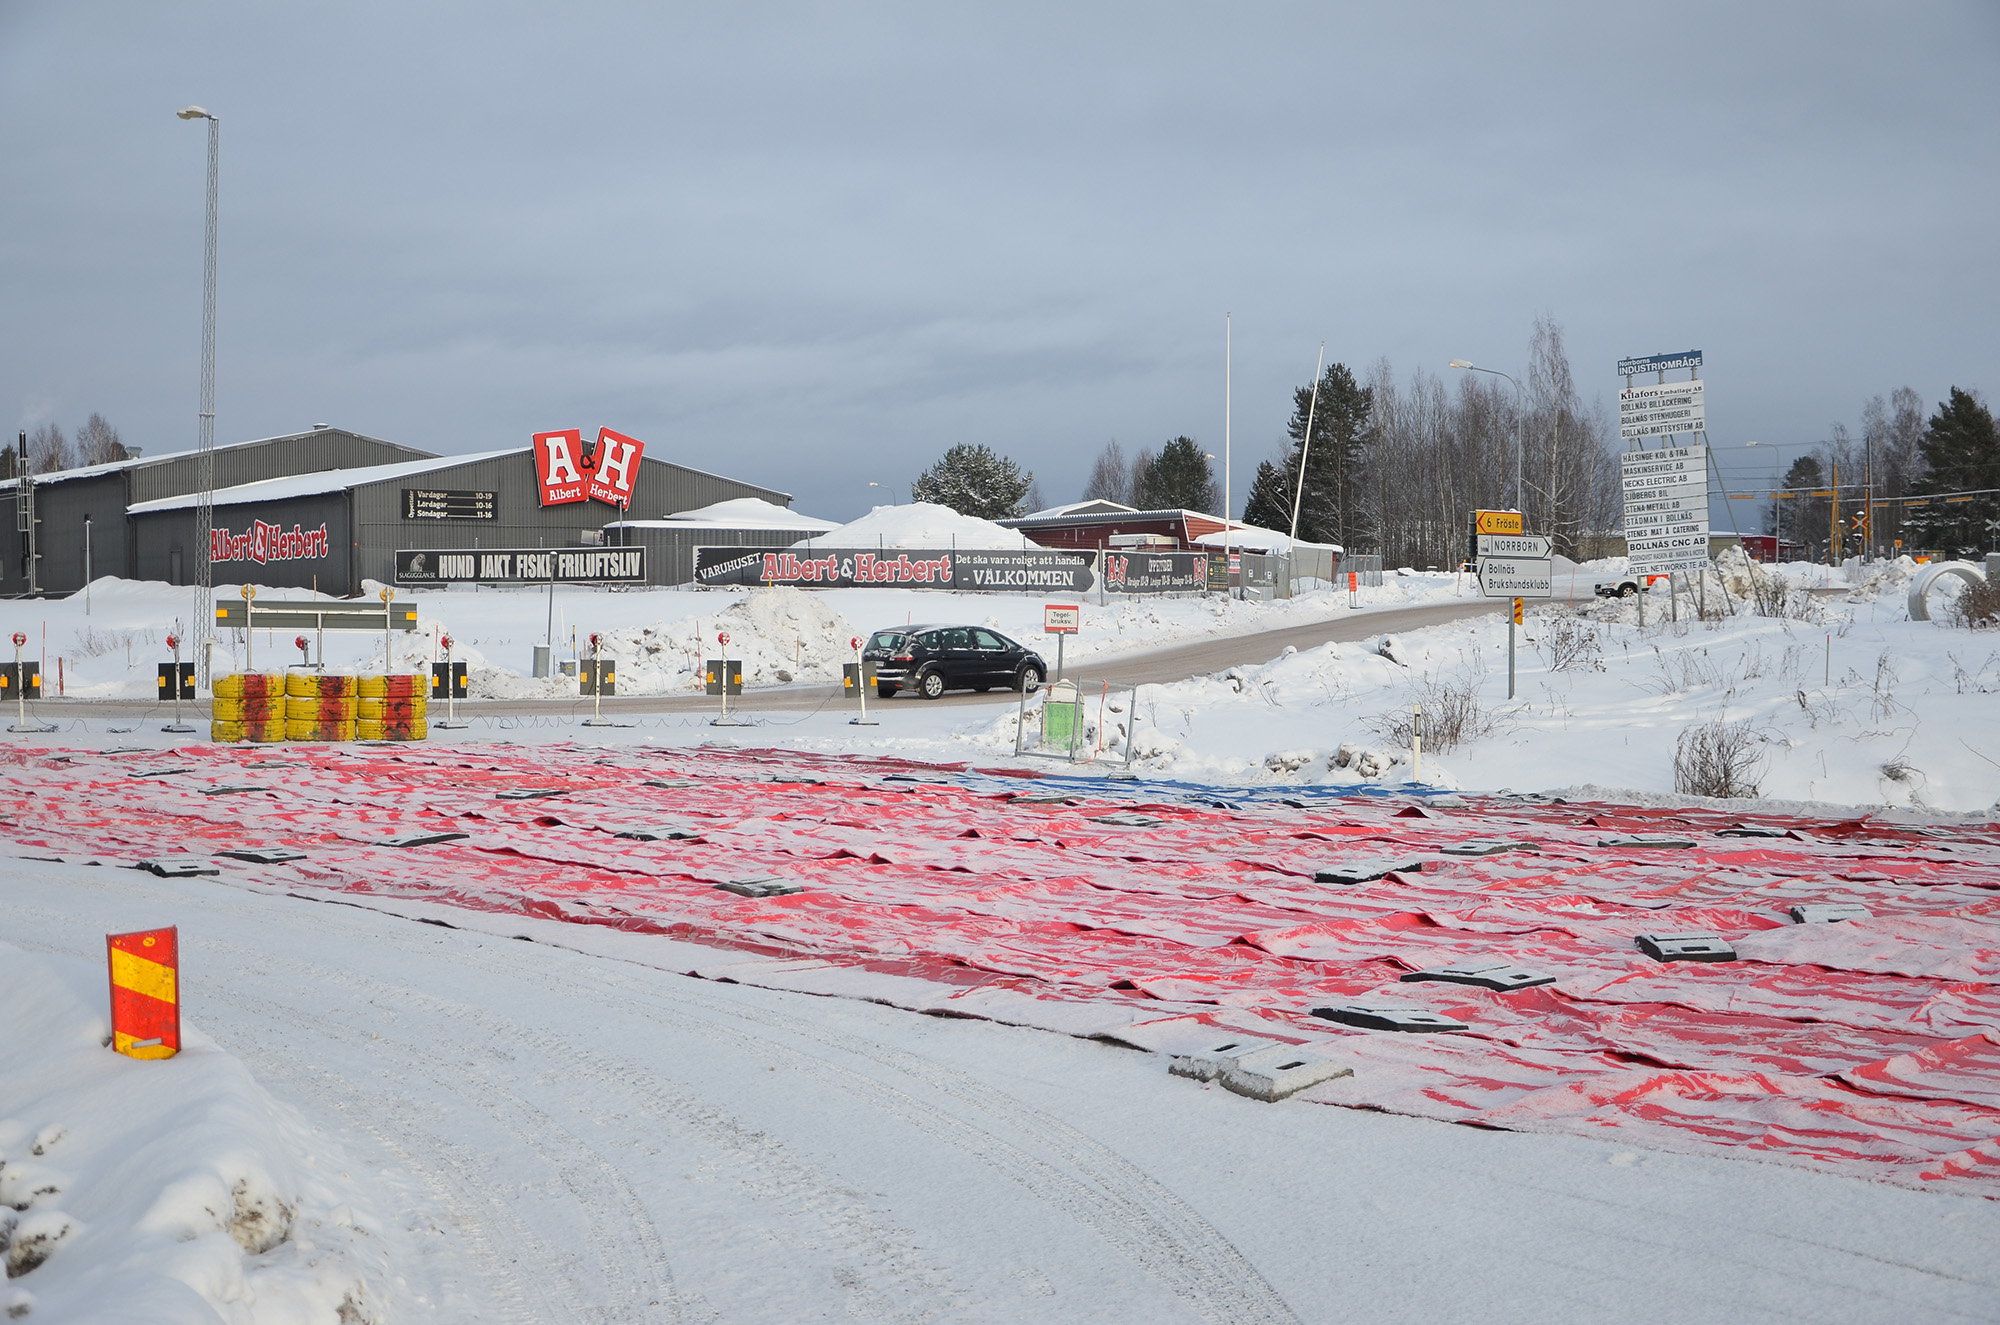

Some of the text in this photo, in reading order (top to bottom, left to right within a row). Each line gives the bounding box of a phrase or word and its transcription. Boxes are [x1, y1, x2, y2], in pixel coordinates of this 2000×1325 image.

[1618, 358, 1650, 367] Norrborns
[1620, 356, 1701, 374] INDUSTRIOMRÅDE
[1621, 390, 1658, 400] Kilafors
[1621, 397, 1692, 412] BOLLNÄS BILLACKERING
[1622, 410, 1690, 424] BOLLNÄS STENHUGGERI
[1622, 426, 1648, 437] BOLLNÄS
[1651, 423, 1692, 434] MATTSYSTEM
[1623, 453, 1652, 462] HÄLSINGE
[1676, 448, 1688, 456] TRÄ
[545, 436, 636, 492] A & H
[1624, 464, 1672, 475] MASKINSERVICE
[1624, 479, 1644, 488] NECKS
[1647, 476, 1676, 486] ELECTRIC
[417, 490, 448, 500] Vardagar
[549, 487, 582, 501] Albert
[590, 484, 628, 505] Herbert
[1625, 491, 1656, 500] SJÖBERGS
[417, 500, 448, 510] Lördagar
[1626, 504, 1645, 514] STENA
[1647, 502, 1670, 511] METALL
[417, 510, 448, 518] Söndagar
[1667, 512, 1692, 522] BOLLNÄS
[1486, 518, 1520, 528] 6 Fröste
[1627, 530, 1648, 538] STENES
[1651, 528, 1662, 536] MAT
[1673, 524, 1699, 534] CATERING
[211, 527, 253, 562] Albert
[268, 522, 328, 560] Herbert
[1494, 540, 1538, 552] NORRBORN
[1630, 540, 1669, 550] BOLLNÄS
[1672, 538, 1690, 547] CNC
[439, 555, 474, 578] HUND
[480, 555, 511, 578] JAKT
[558, 552, 640, 578] FRILUFTSLIV
[956, 554, 1085, 567] Det ska vara roligt att handla
[700, 553, 952, 582] VARUHUSET Albert & Herbert
[1108, 556, 1116, 582] A
[1118, 555, 1128, 585] H
[1488, 564, 1515, 574] Bollnäs
[1630, 566, 1648, 574] ELTEL
[1651, 562, 1687, 572] NETWORKS
[973, 568, 1074, 586] VÄLKOMMEN
[1488, 578, 1549, 590] Brukshundsklubb
